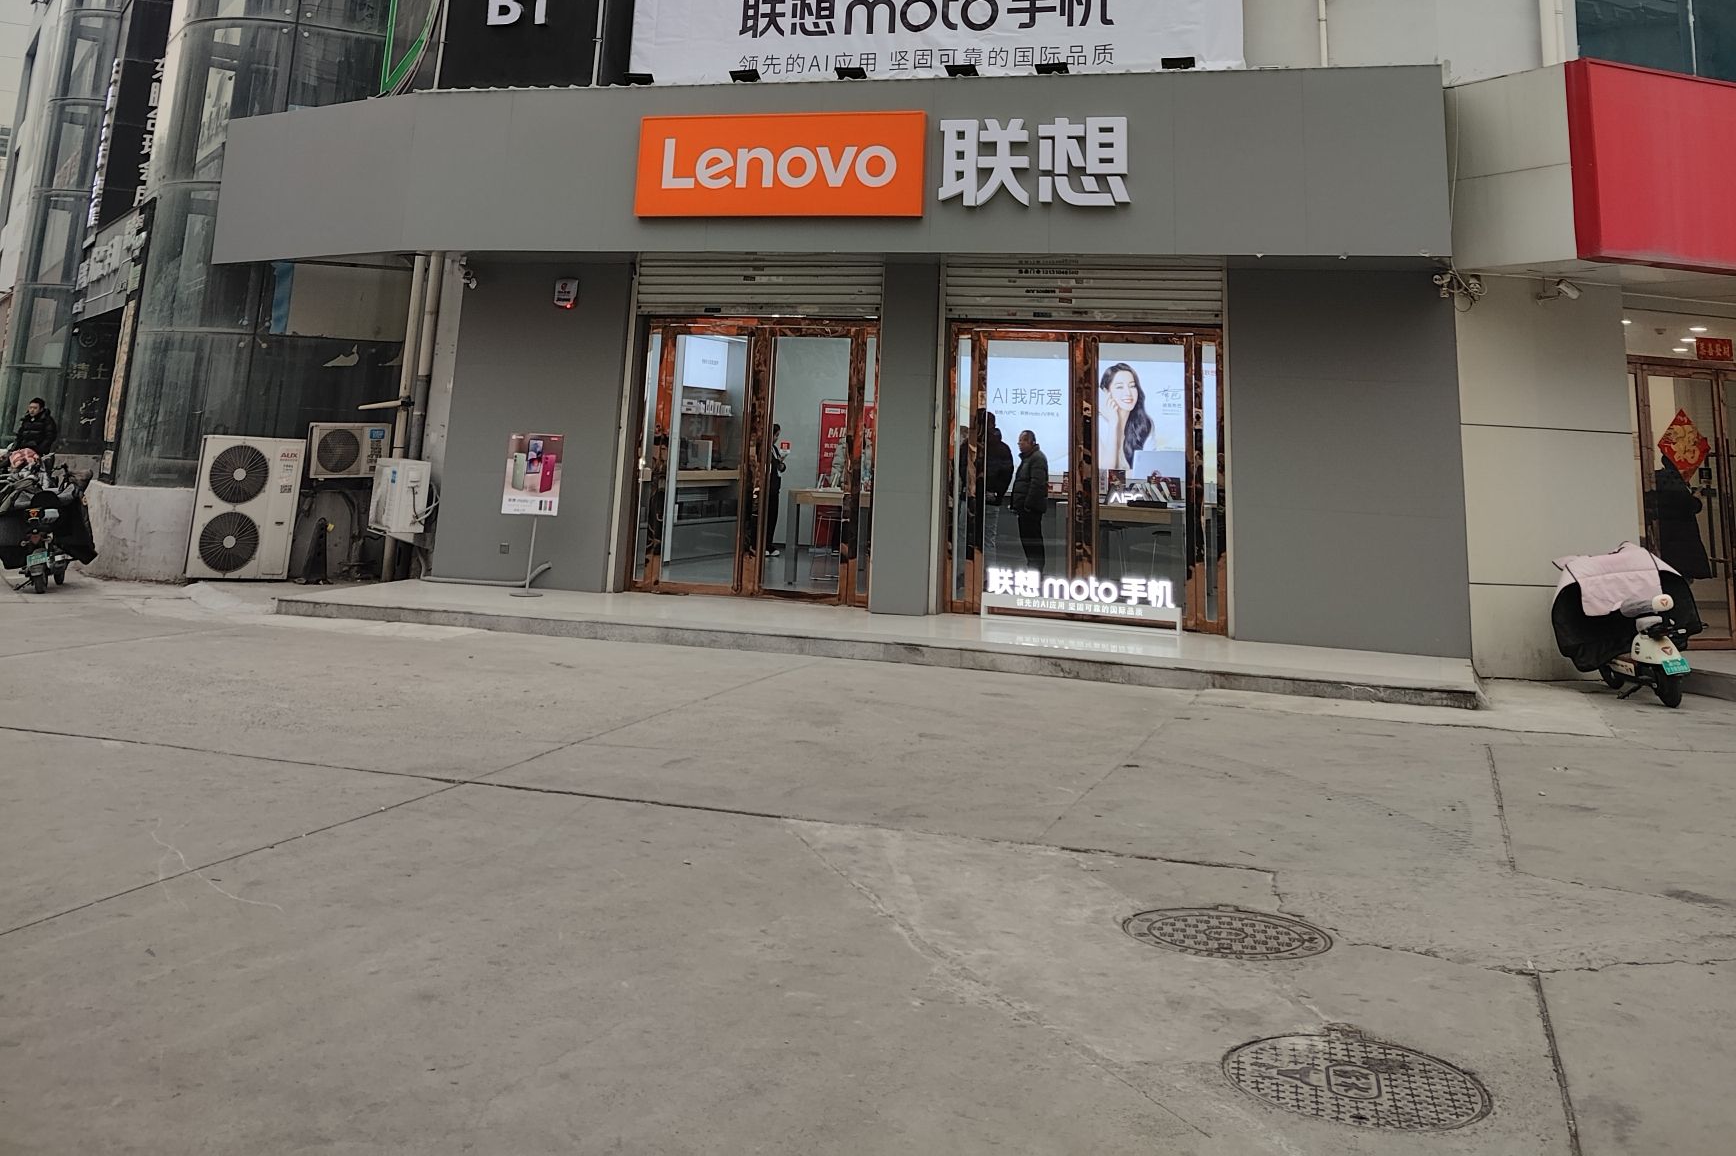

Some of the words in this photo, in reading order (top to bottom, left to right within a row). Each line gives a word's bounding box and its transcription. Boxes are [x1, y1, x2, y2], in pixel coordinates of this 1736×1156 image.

[738, 52, 877, 75] 领先的AI应用
[888, 44, 1115, 71] 坚固可靠的国际品质
[660, 137, 898, 190] Lenovo
[937, 115, 1132, 208] 联想
[986, 566, 1176, 609] 联想moto手机
